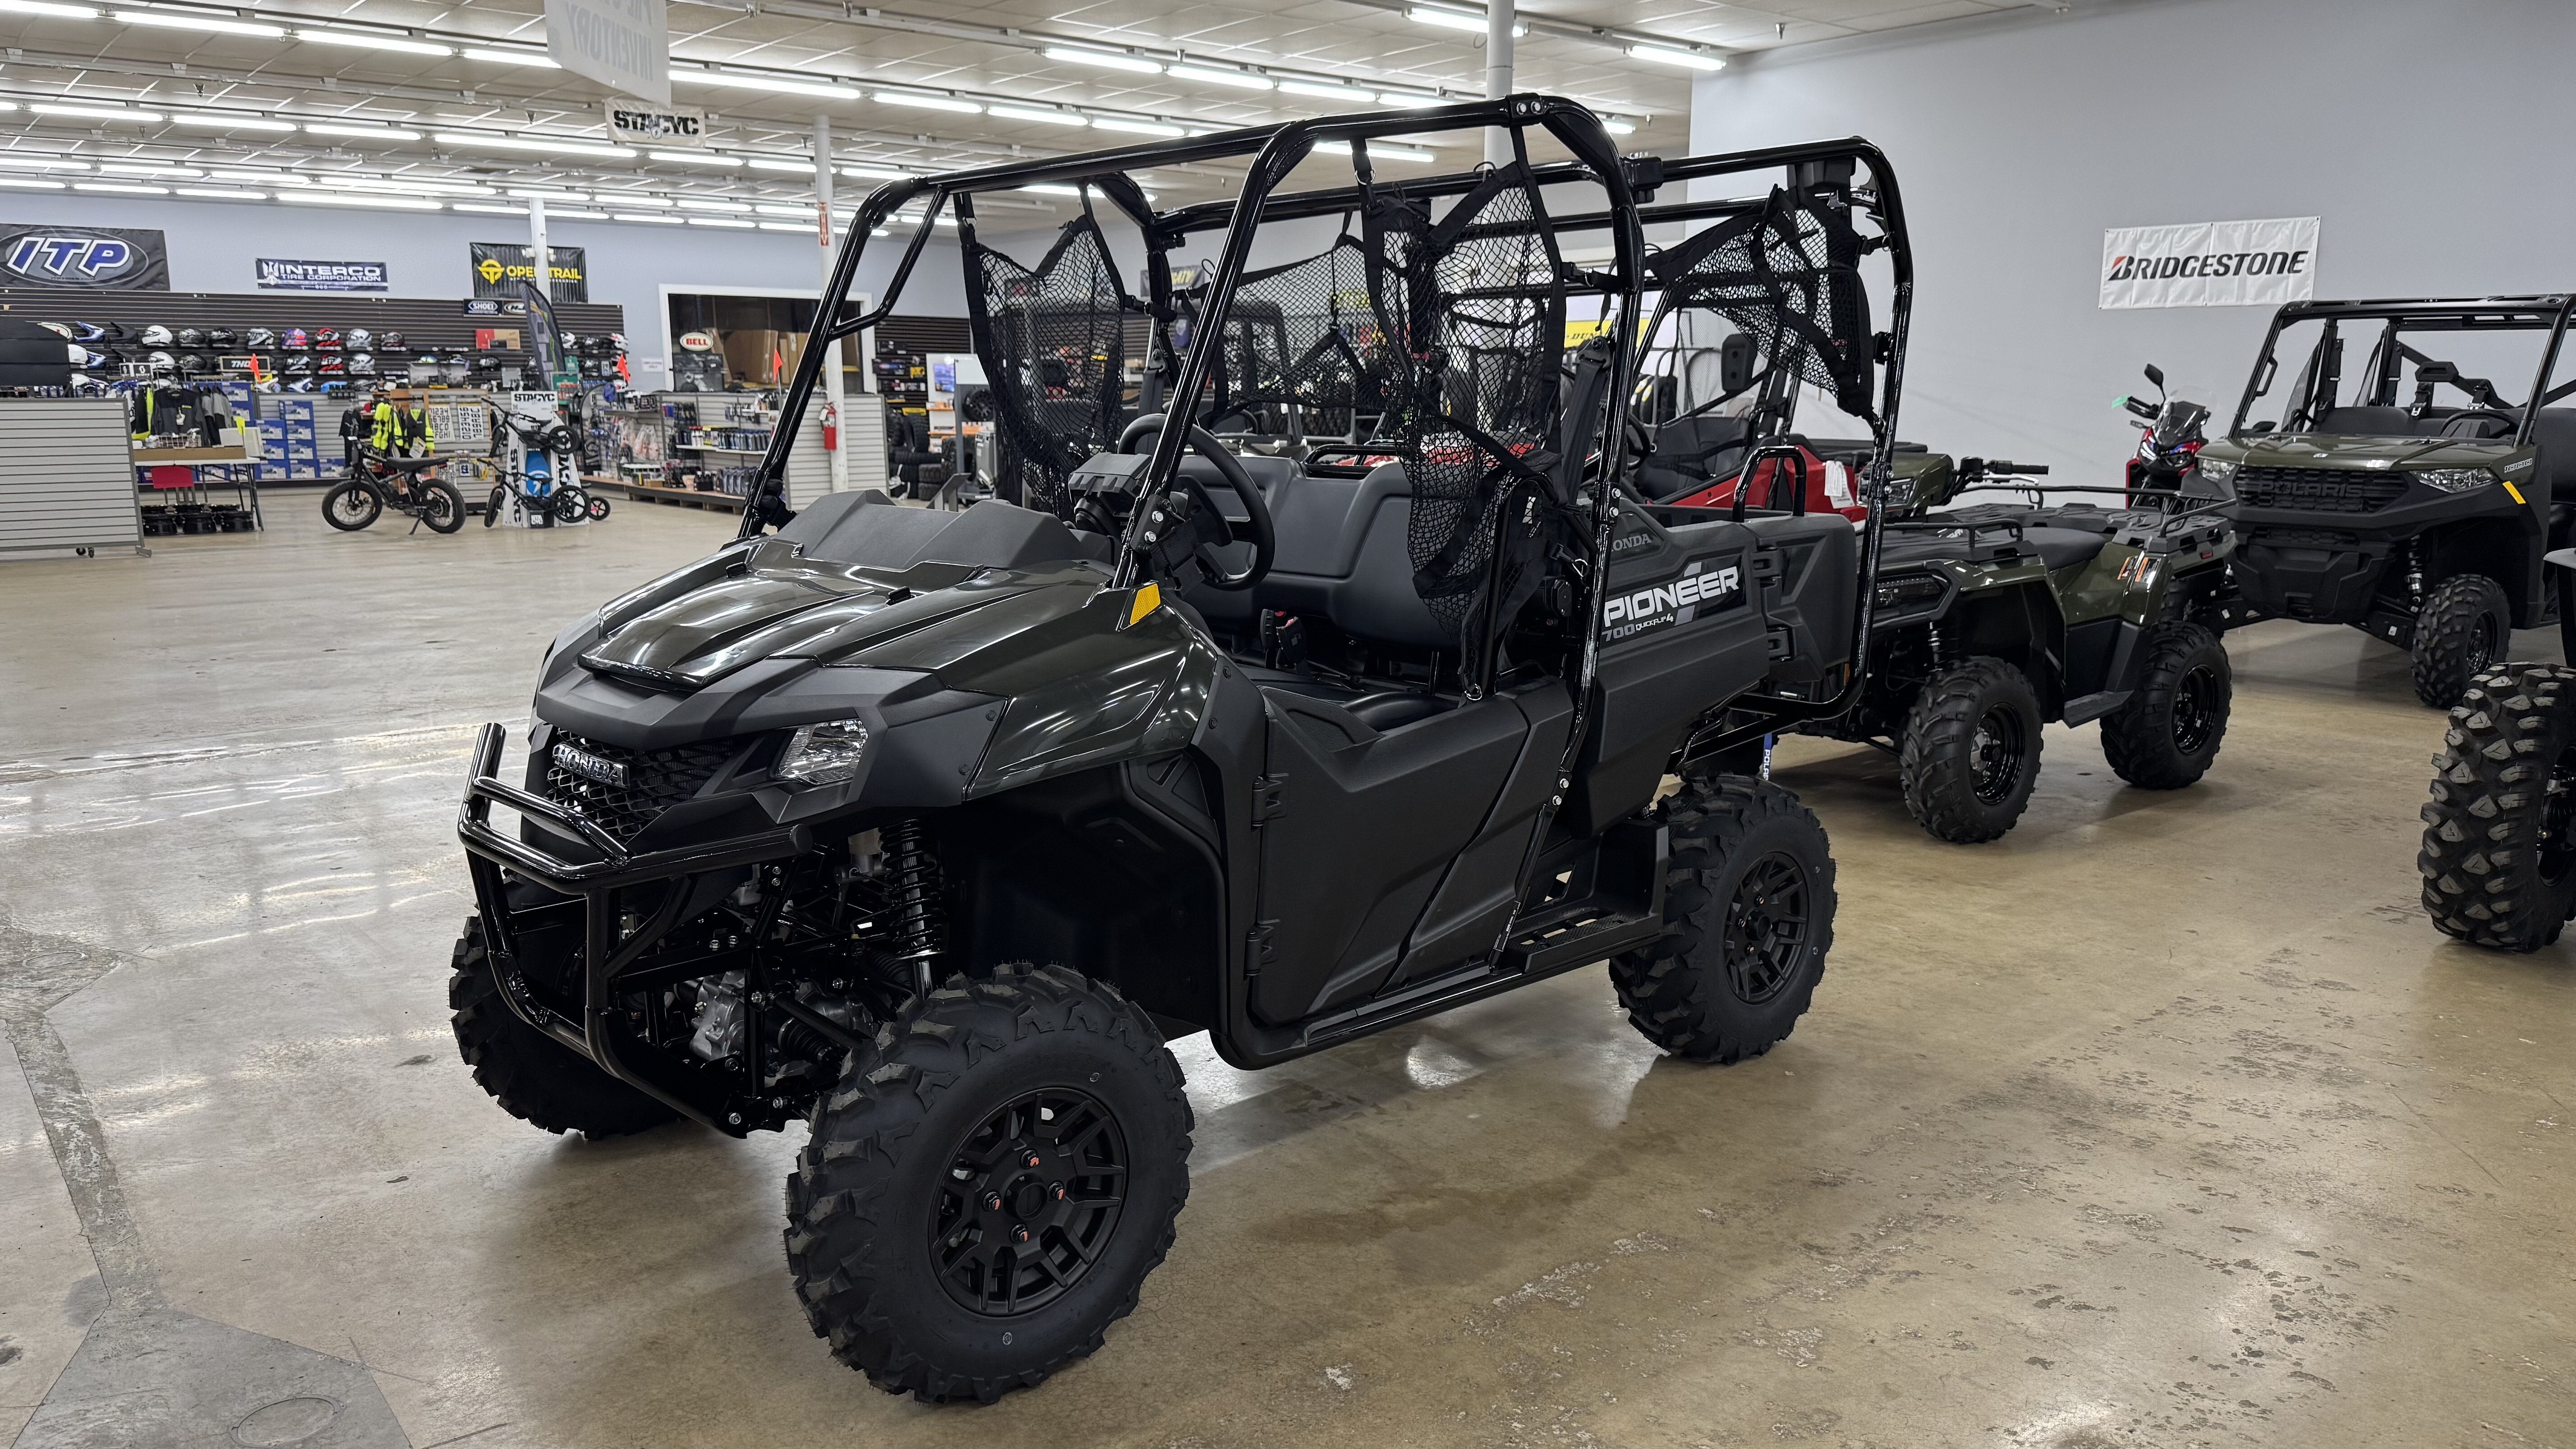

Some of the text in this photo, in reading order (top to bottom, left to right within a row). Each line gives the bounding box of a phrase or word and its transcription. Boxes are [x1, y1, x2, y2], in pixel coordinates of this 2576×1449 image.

[613, 110, 699, 135] STACYC
[7, 236, 130, 277] ITP
[2107, 250, 2309, 281] BRIDGESTONE
[514, 393, 555, 402] STACYC
[433, 431, 451, 439] FGHI
[2504, 458, 2533, 473] 1000
[2258, 481, 2364, 498] POLARIS
[1611, 533, 1652, 552] ONDA
[1604, 566, 1739, 627] PIONEER
[1601, 624, 1636, 642] 700
[557, 744, 626, 787] HONDA
